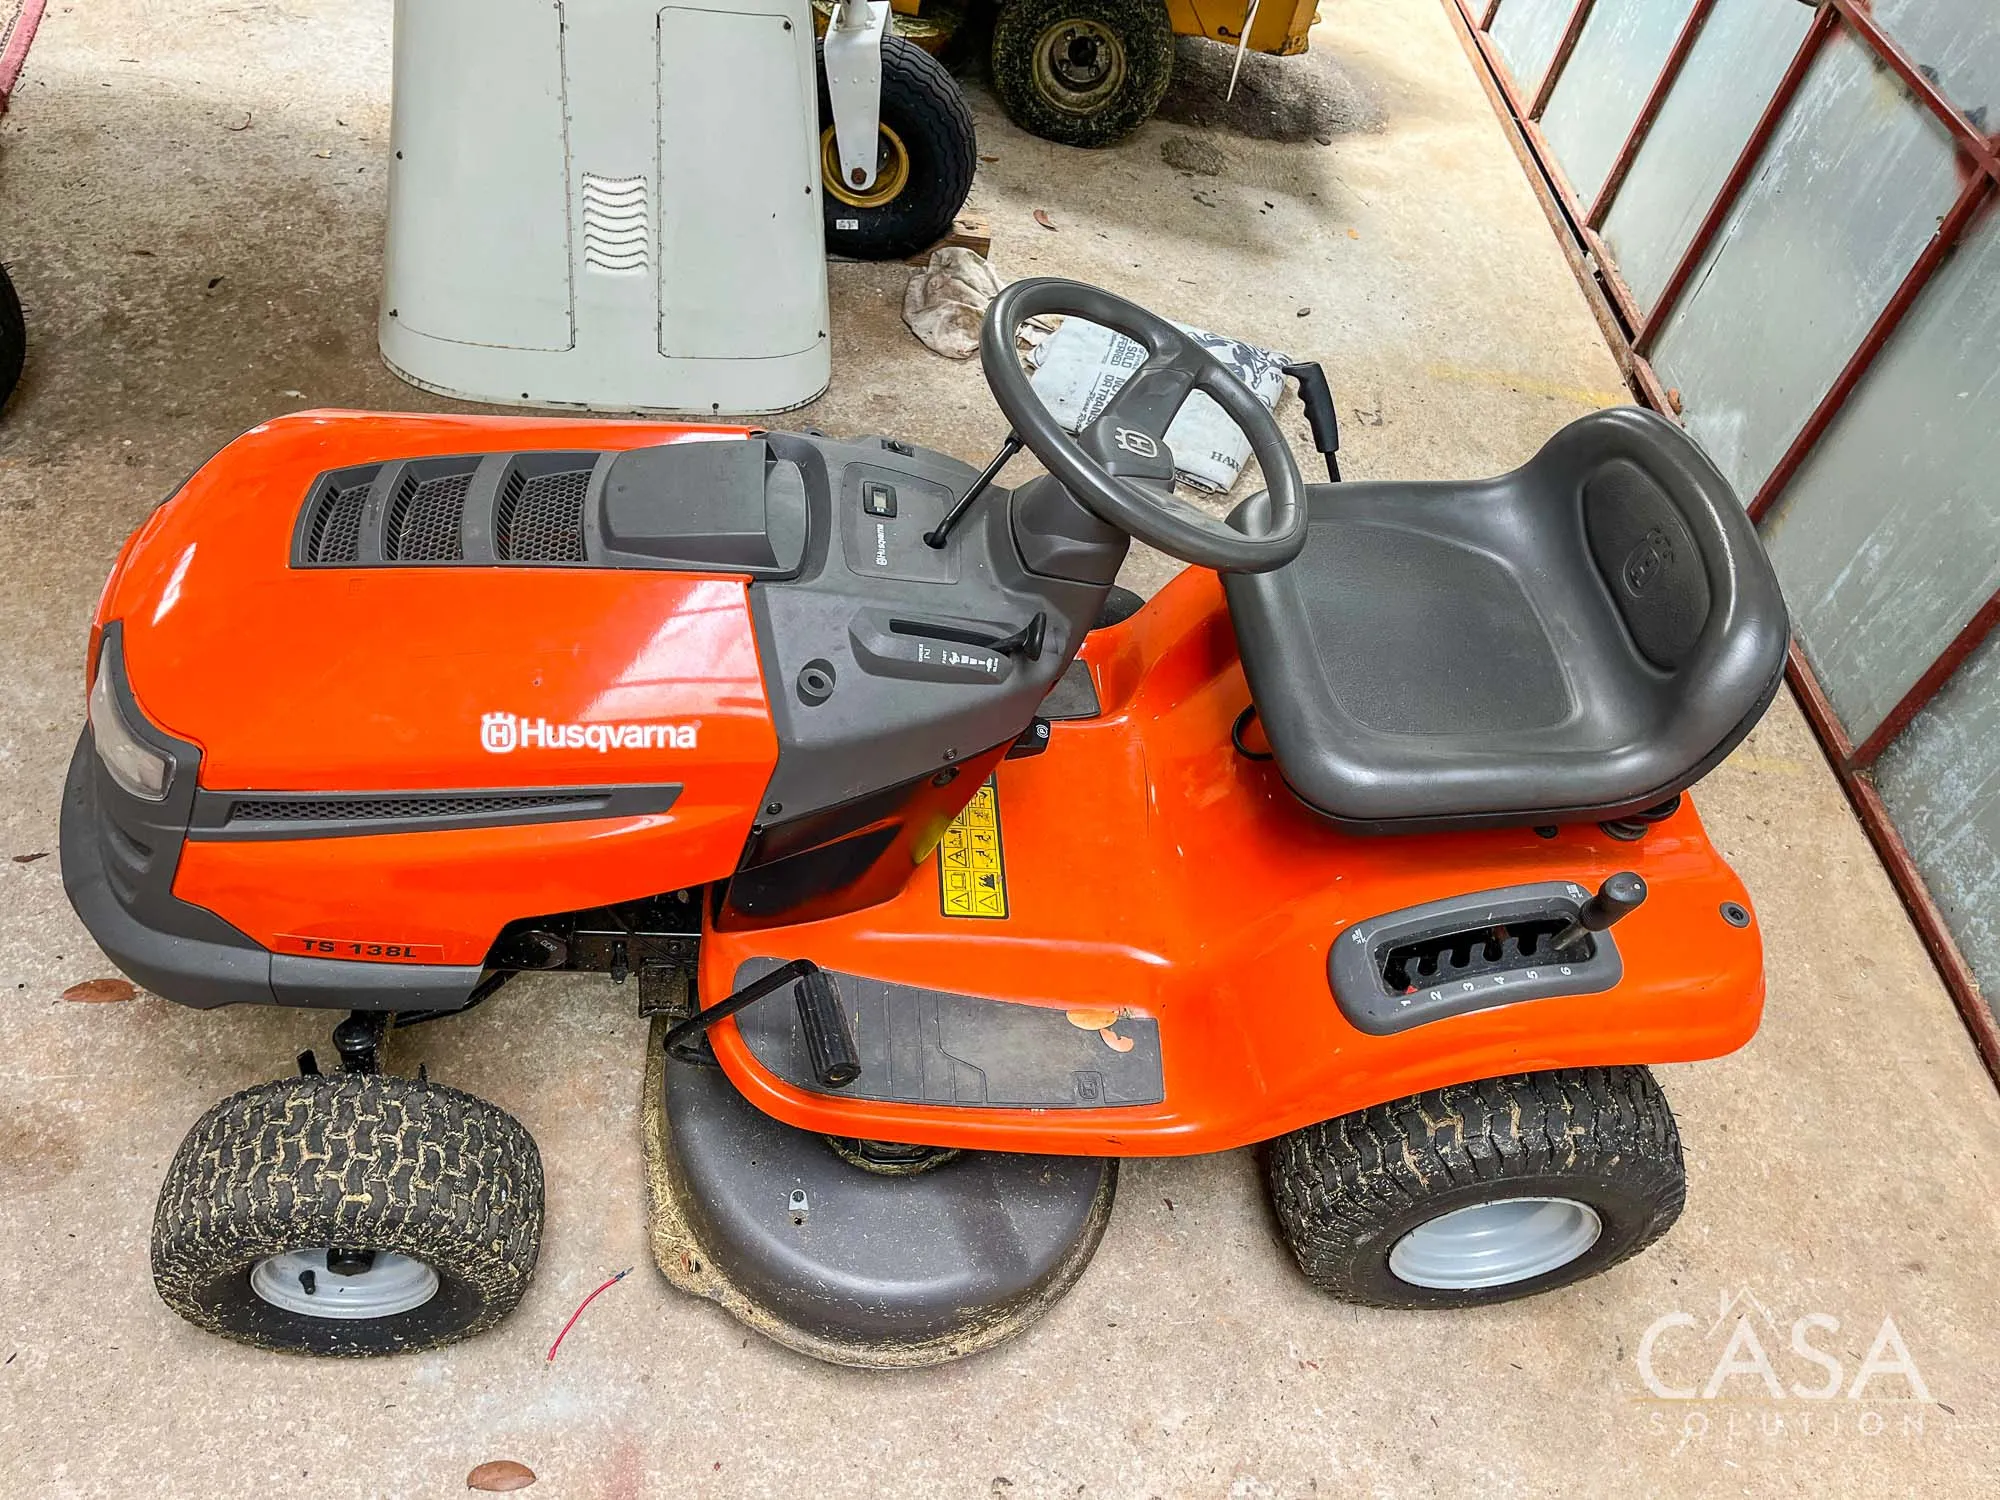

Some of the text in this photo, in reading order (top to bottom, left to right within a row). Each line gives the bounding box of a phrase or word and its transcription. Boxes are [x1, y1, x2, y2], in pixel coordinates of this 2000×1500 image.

[1121, 345, 1138, 368] SOLD
[520, 718, 697, 753] Husqvarna
[303, 939, 417, 958] TS 138L
[1526, 970, 1538, 980] 5
[1560, 966, 1572, 976] 6
[1493, 976, 1505, 985] 4
[1462, 982, 1475, 991] 3
[1430, 990, 1442, 1001] 2
[1400, 999, 1411, 1007] 1
